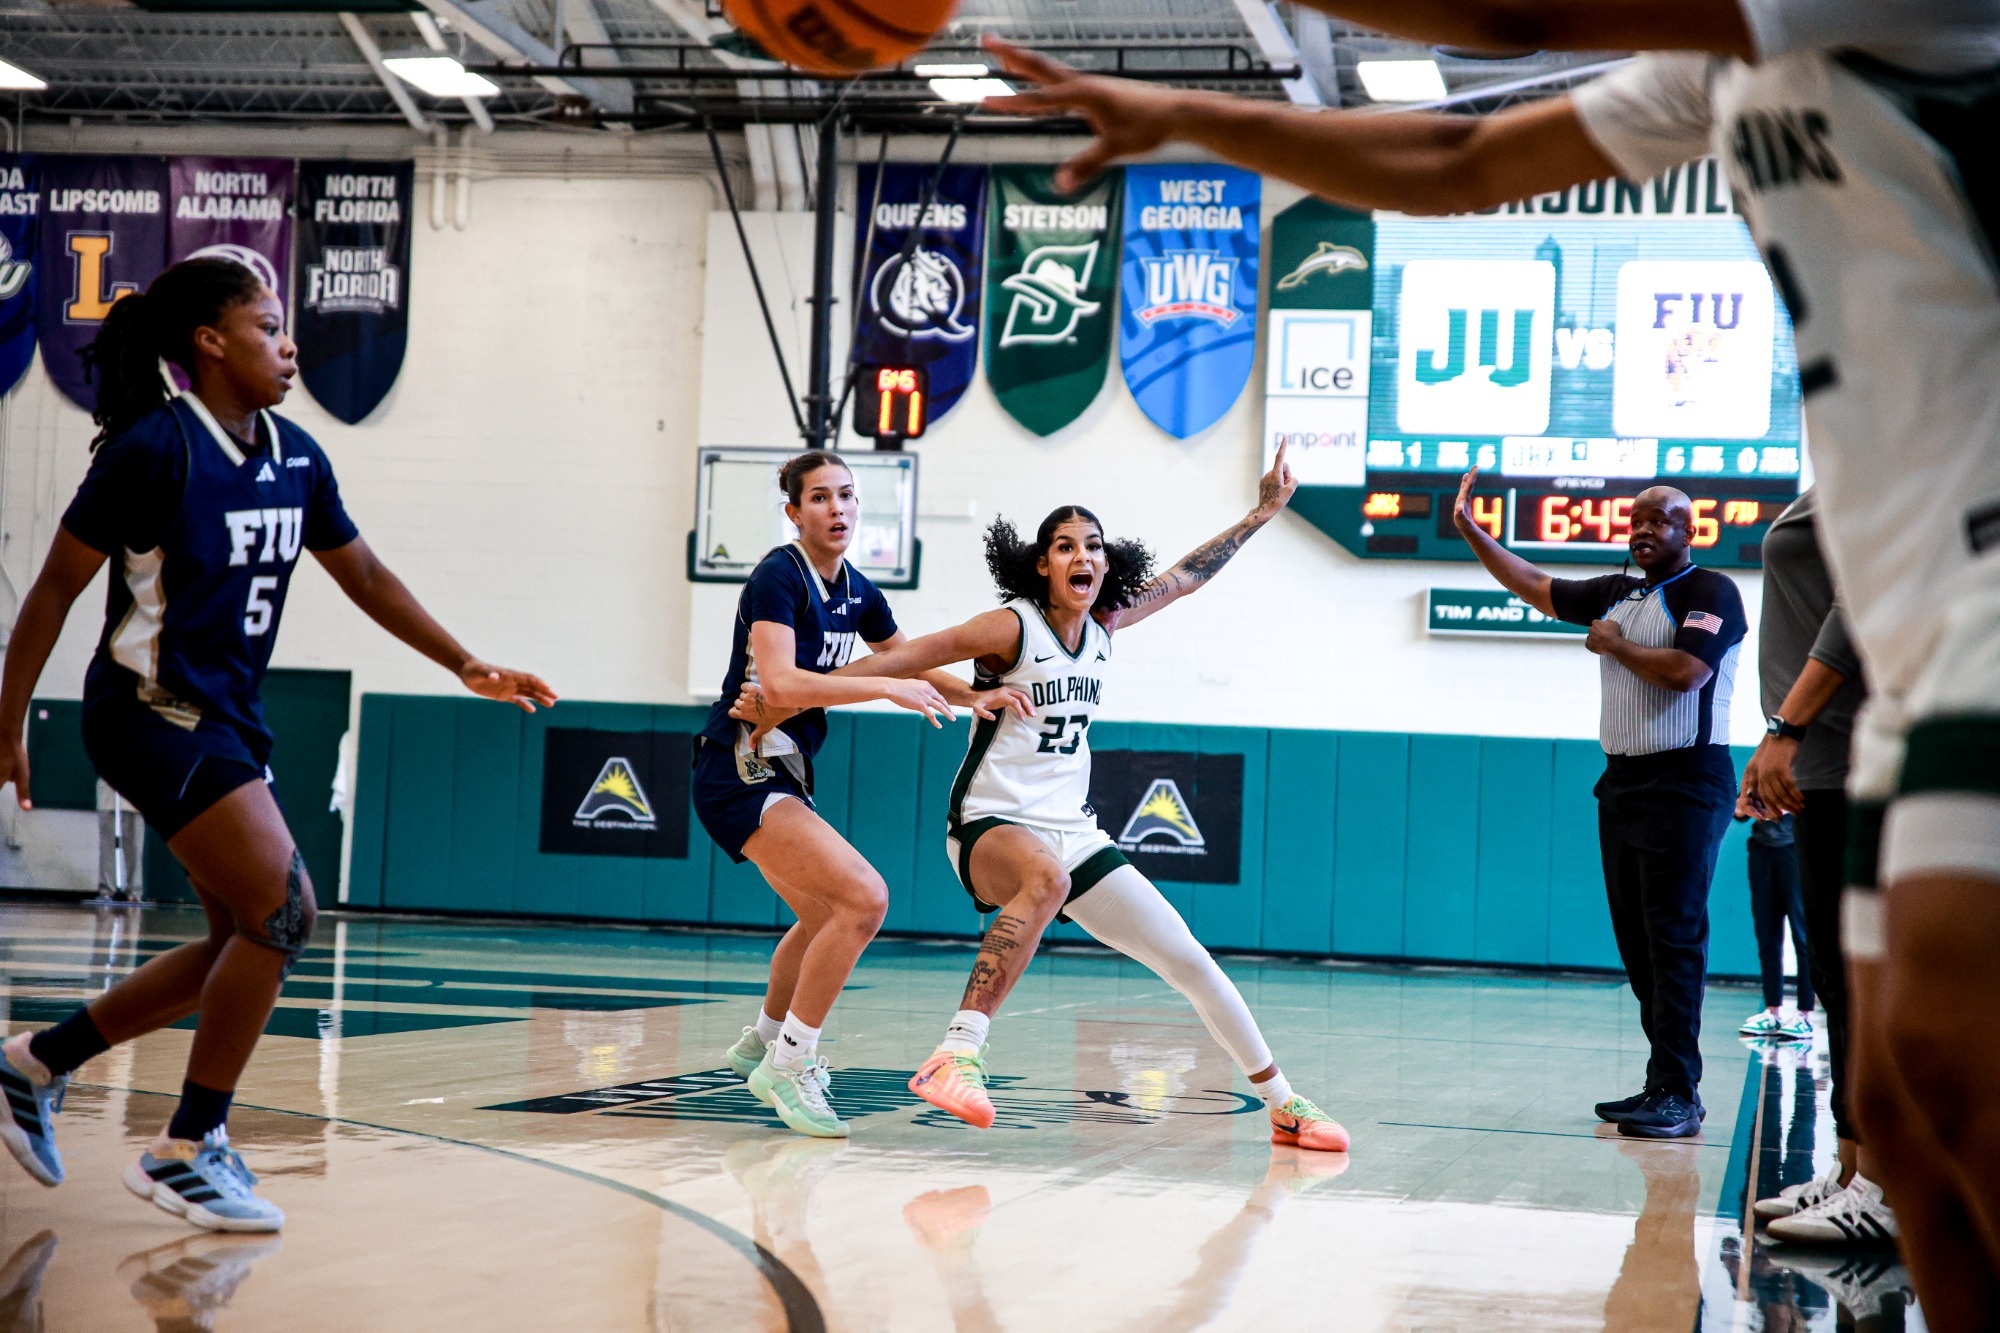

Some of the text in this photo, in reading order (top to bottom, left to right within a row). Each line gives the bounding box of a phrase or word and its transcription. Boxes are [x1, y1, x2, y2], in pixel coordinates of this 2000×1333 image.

[195, 172, 267, 196] NORTH
[326, 175, 395, 198] NORTH
[1160, 180, 1226, 203] WEST
[50, 188, 161, 214] LIPSCOMB
[176, 197, 281, 221] ALABAMA
[315, 201, 399, 223] FLORIDA
[875, 203, 967, 230] QUEENS
[1004, 205, 1107, 230] STETSON
[1141, 206, 1243, 230] GEORGIA
[324, 249, 384, 272] NORTH
[308, 267, 398, 303] FLORIDA
[1148, 253, 1230, 306] UWG
[1414, 309, 1536, 388] JU
[1653, 293, 1743, 330] FIU
[1274, 431, 1357, 450] pinpoint
[225, 507, 303, 566] FIU
[243, 576, 279, 636] 5
[1435, 605, 1472, 619] TIM
[1476, 606, 1524, 622] AND
[1036, 714, 1089, 755] 23
